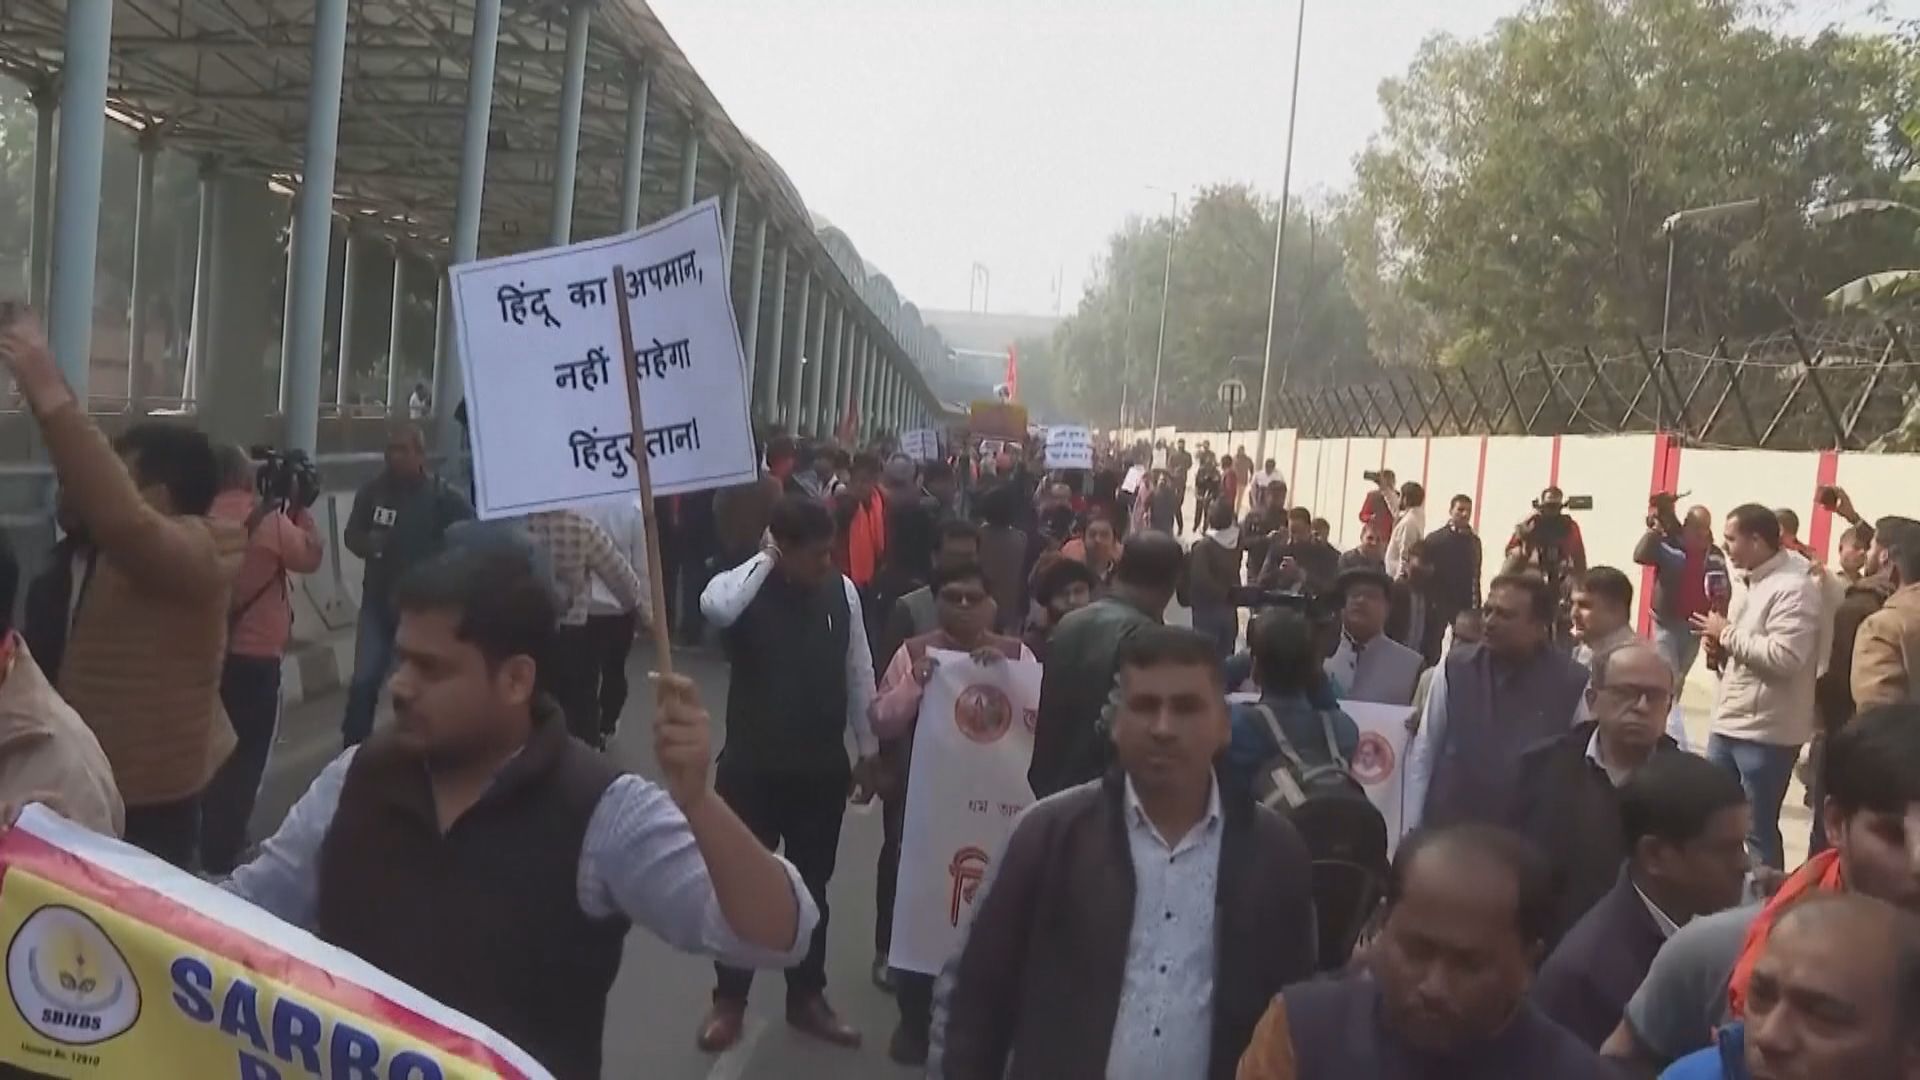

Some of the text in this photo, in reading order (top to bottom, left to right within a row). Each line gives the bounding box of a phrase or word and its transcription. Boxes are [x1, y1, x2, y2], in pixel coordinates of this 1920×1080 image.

[497, 251, 703, 328] हिंदू का अपमान,
[554, 338, 691, 392] नहीं सहेगा
[42, 1008, 102, 1031] SBHBS
